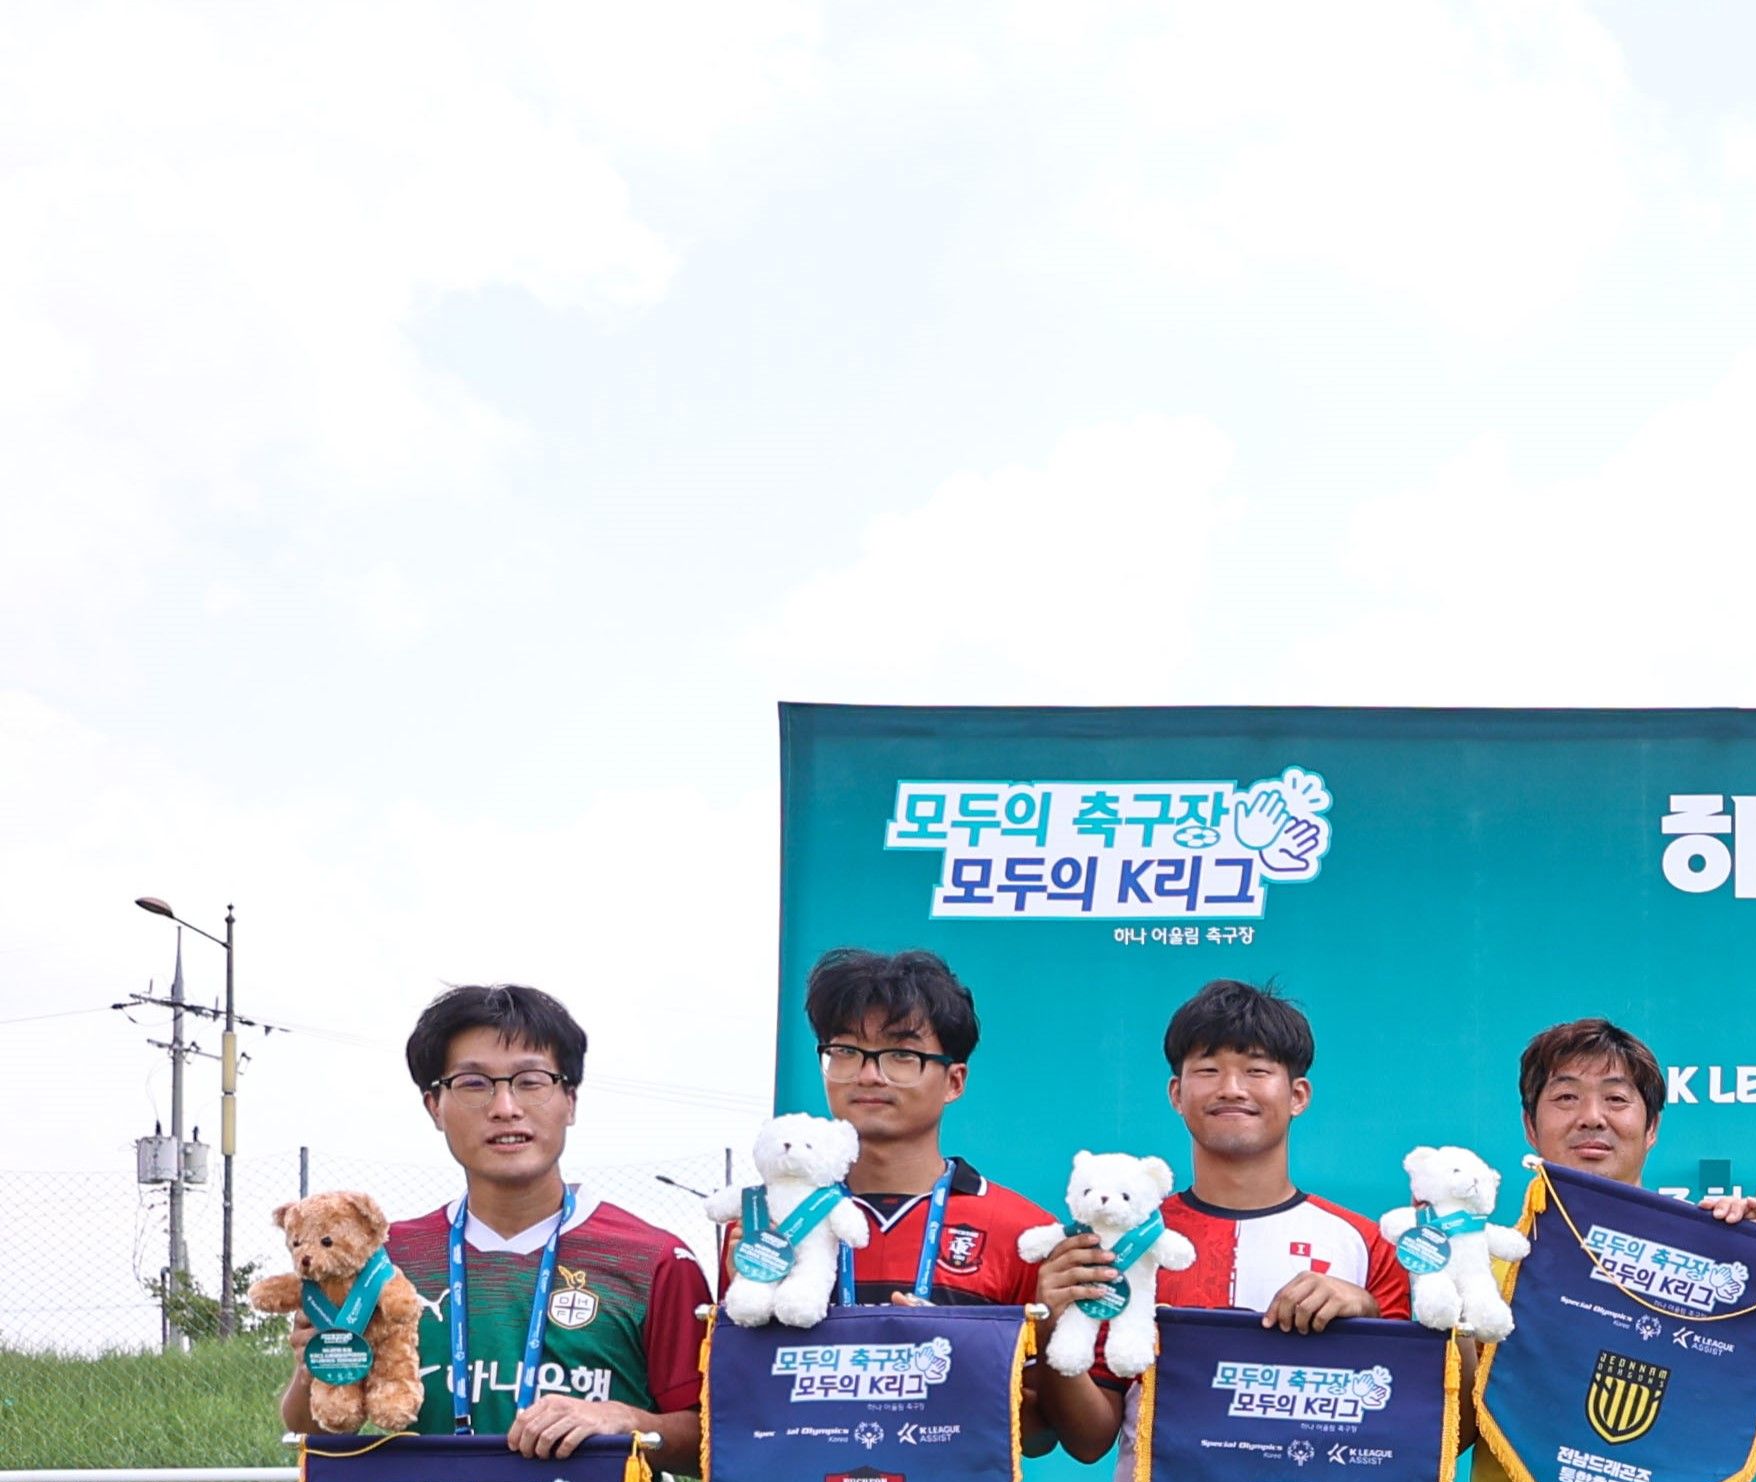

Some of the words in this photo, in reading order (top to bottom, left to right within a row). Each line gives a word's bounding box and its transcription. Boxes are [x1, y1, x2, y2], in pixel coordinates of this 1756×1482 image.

[896, 791, 1053, 847] 모두의
[1074, 793, 1230, 847] 축구장
[943, 856, 1100, 911] 모두의
[1119, 857, 1255, 911] K리그
[1114, 927, 1146, 945] 하나
[1151, 927, 1200, 945] 어울림
[1207, 927, 1254, 945] 축구장
[1666, 1067, 1698, 1103] K
[1588, 1229, 1648, 1264] 모두의
[1650, 1247, 1710, 1280] 축구장
[1598, 1257, 1658, 1292] 모두의
[1660, 1275, 1715, 1306] K리그
[777, 1347, 840, 1371] 모두의
[850, 1348, 914, 1371] 축구장
[1600, 1353, 1668, 1380] JEONNAM
[446, 1362, 612, 1403] 하나은행
[795, 1375, 859, 1395] 모두의
[869, 1374, 924, 1395] K리그
[1217, 1366, 1279, 1389] 모두의
[1287, 1370, 1353, 1393] 축구장
[1233, 1393, 1294, 1414] 모두의
[1305, 1398, 1359, 1417] K리그
[920, 1426, 927, 1434] K
[929, 1425, 960, 1433] LEAGUE
[920, 1434, 951, 1442] ASSIST
